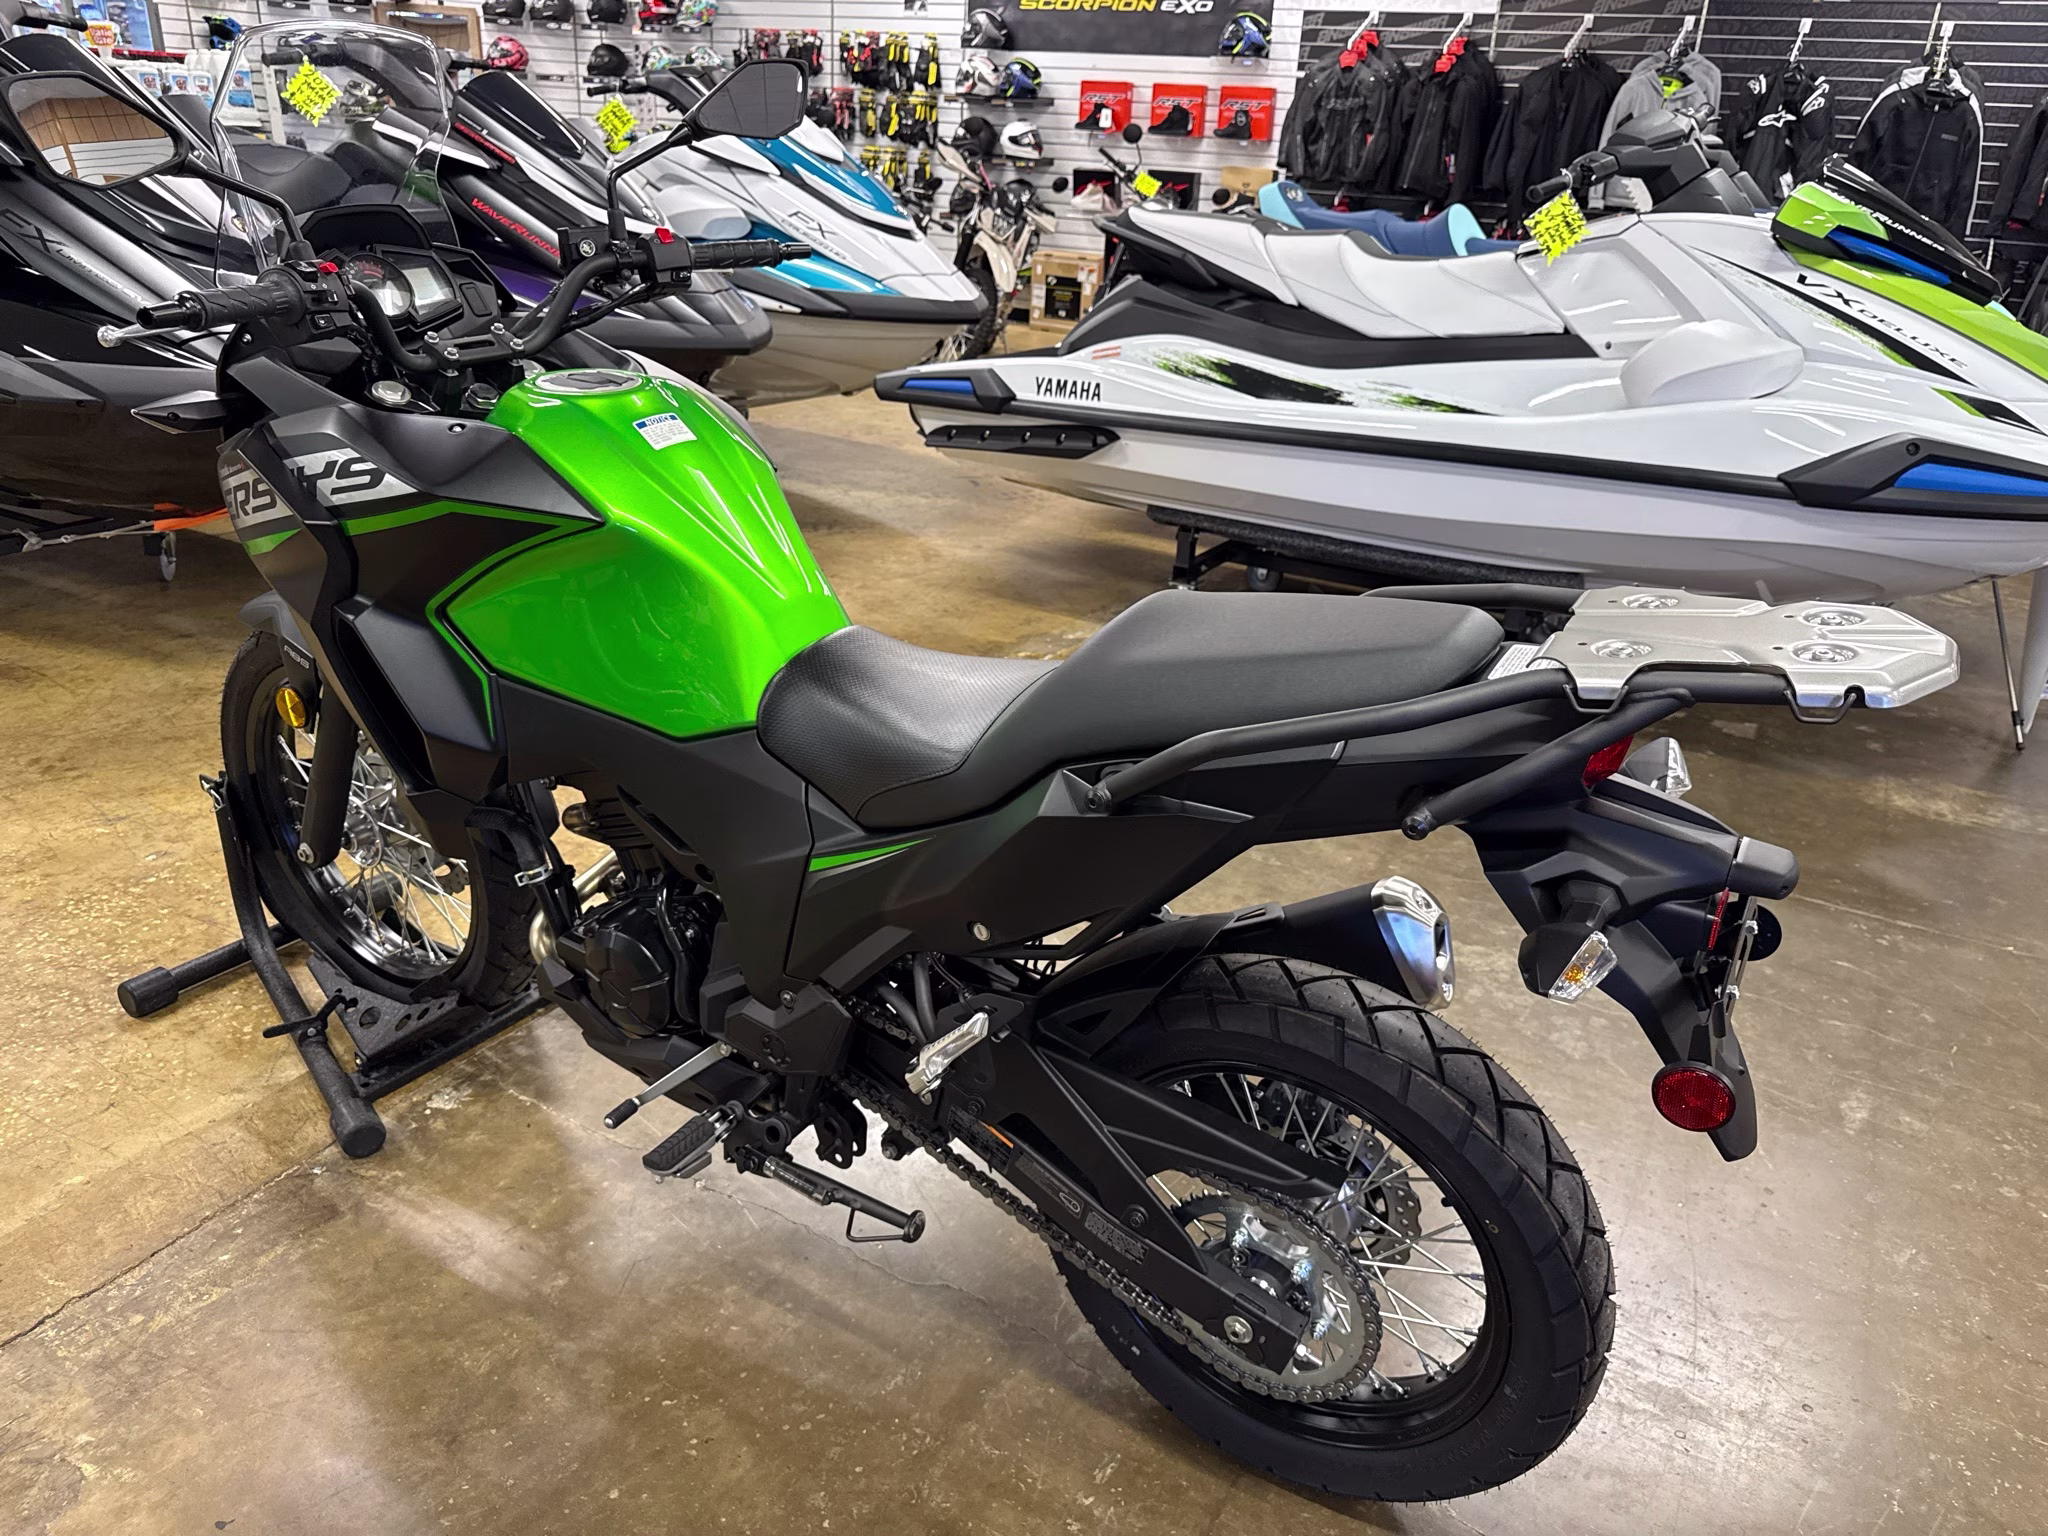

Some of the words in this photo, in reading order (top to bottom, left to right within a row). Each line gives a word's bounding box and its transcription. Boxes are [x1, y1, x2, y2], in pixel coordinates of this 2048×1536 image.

[1019, 0, 1156, 12] SCORPION
[1081, 92, 1126, 104] RST
[1154, 96, 1203, 108] RST
[1221, 100, 1272, 111] RST
[787, 211, 838, 240] FX
[1797, 273, 1864, 309] VX
[1859, 309, 1969, 370] DELUXE
[1036, 376, 1101, 402] YAMAHA
[284, 645, 310, 669] ABS
